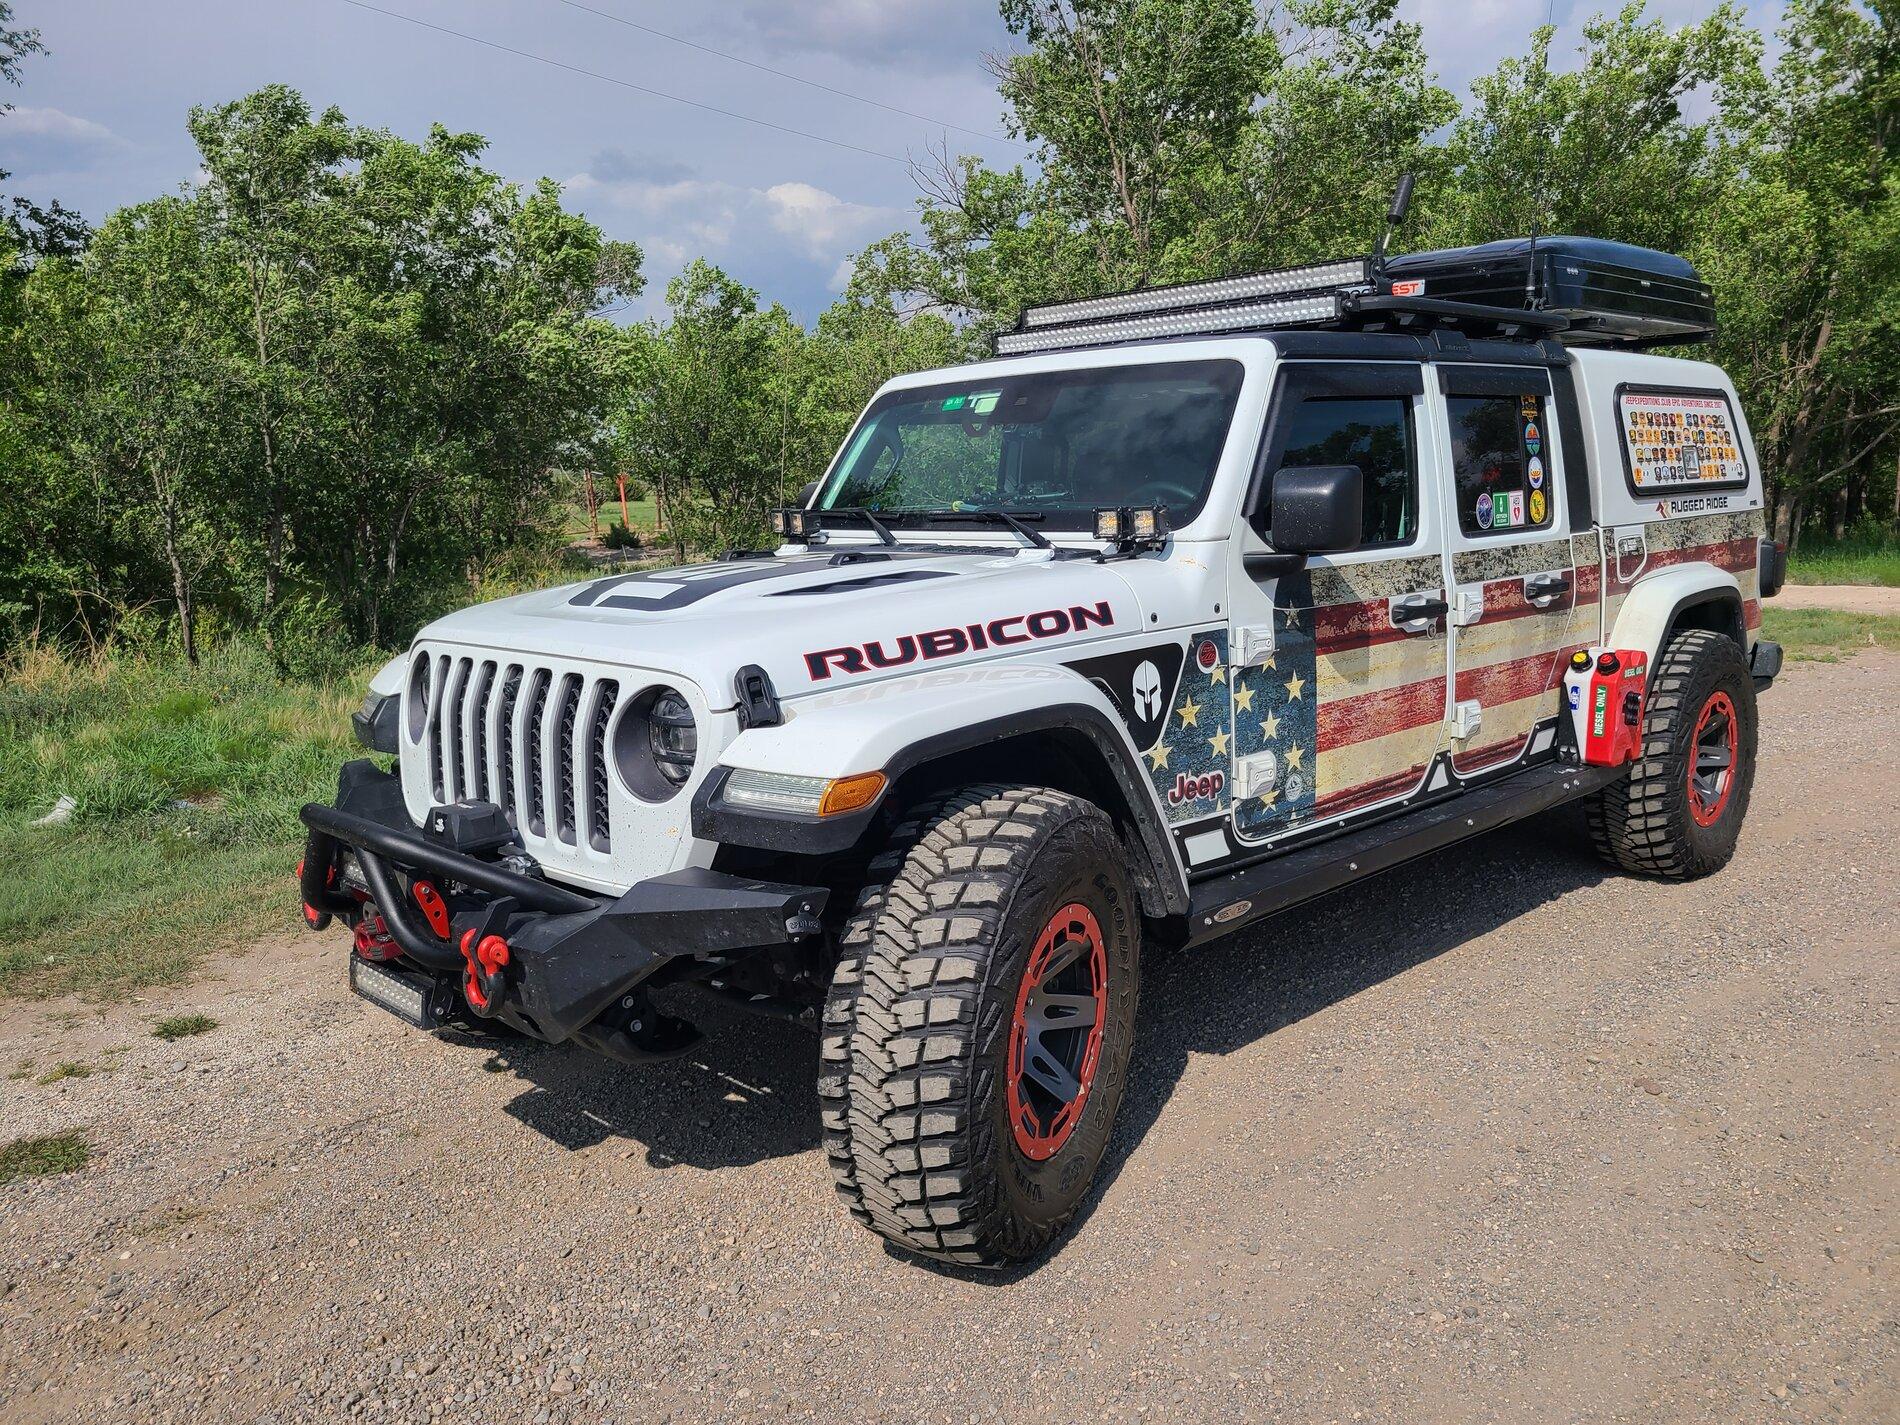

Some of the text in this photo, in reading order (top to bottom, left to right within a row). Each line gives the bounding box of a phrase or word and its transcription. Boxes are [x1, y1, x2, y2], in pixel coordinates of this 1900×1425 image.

[1671, 496, 1728, 513] RUGGED RIDGE
[803, 601, 1115, 681] RUBICON
[1594, 688, 1606, 735] DIESEL ONLY
[1168, 770, 1225, 806] Jeep
